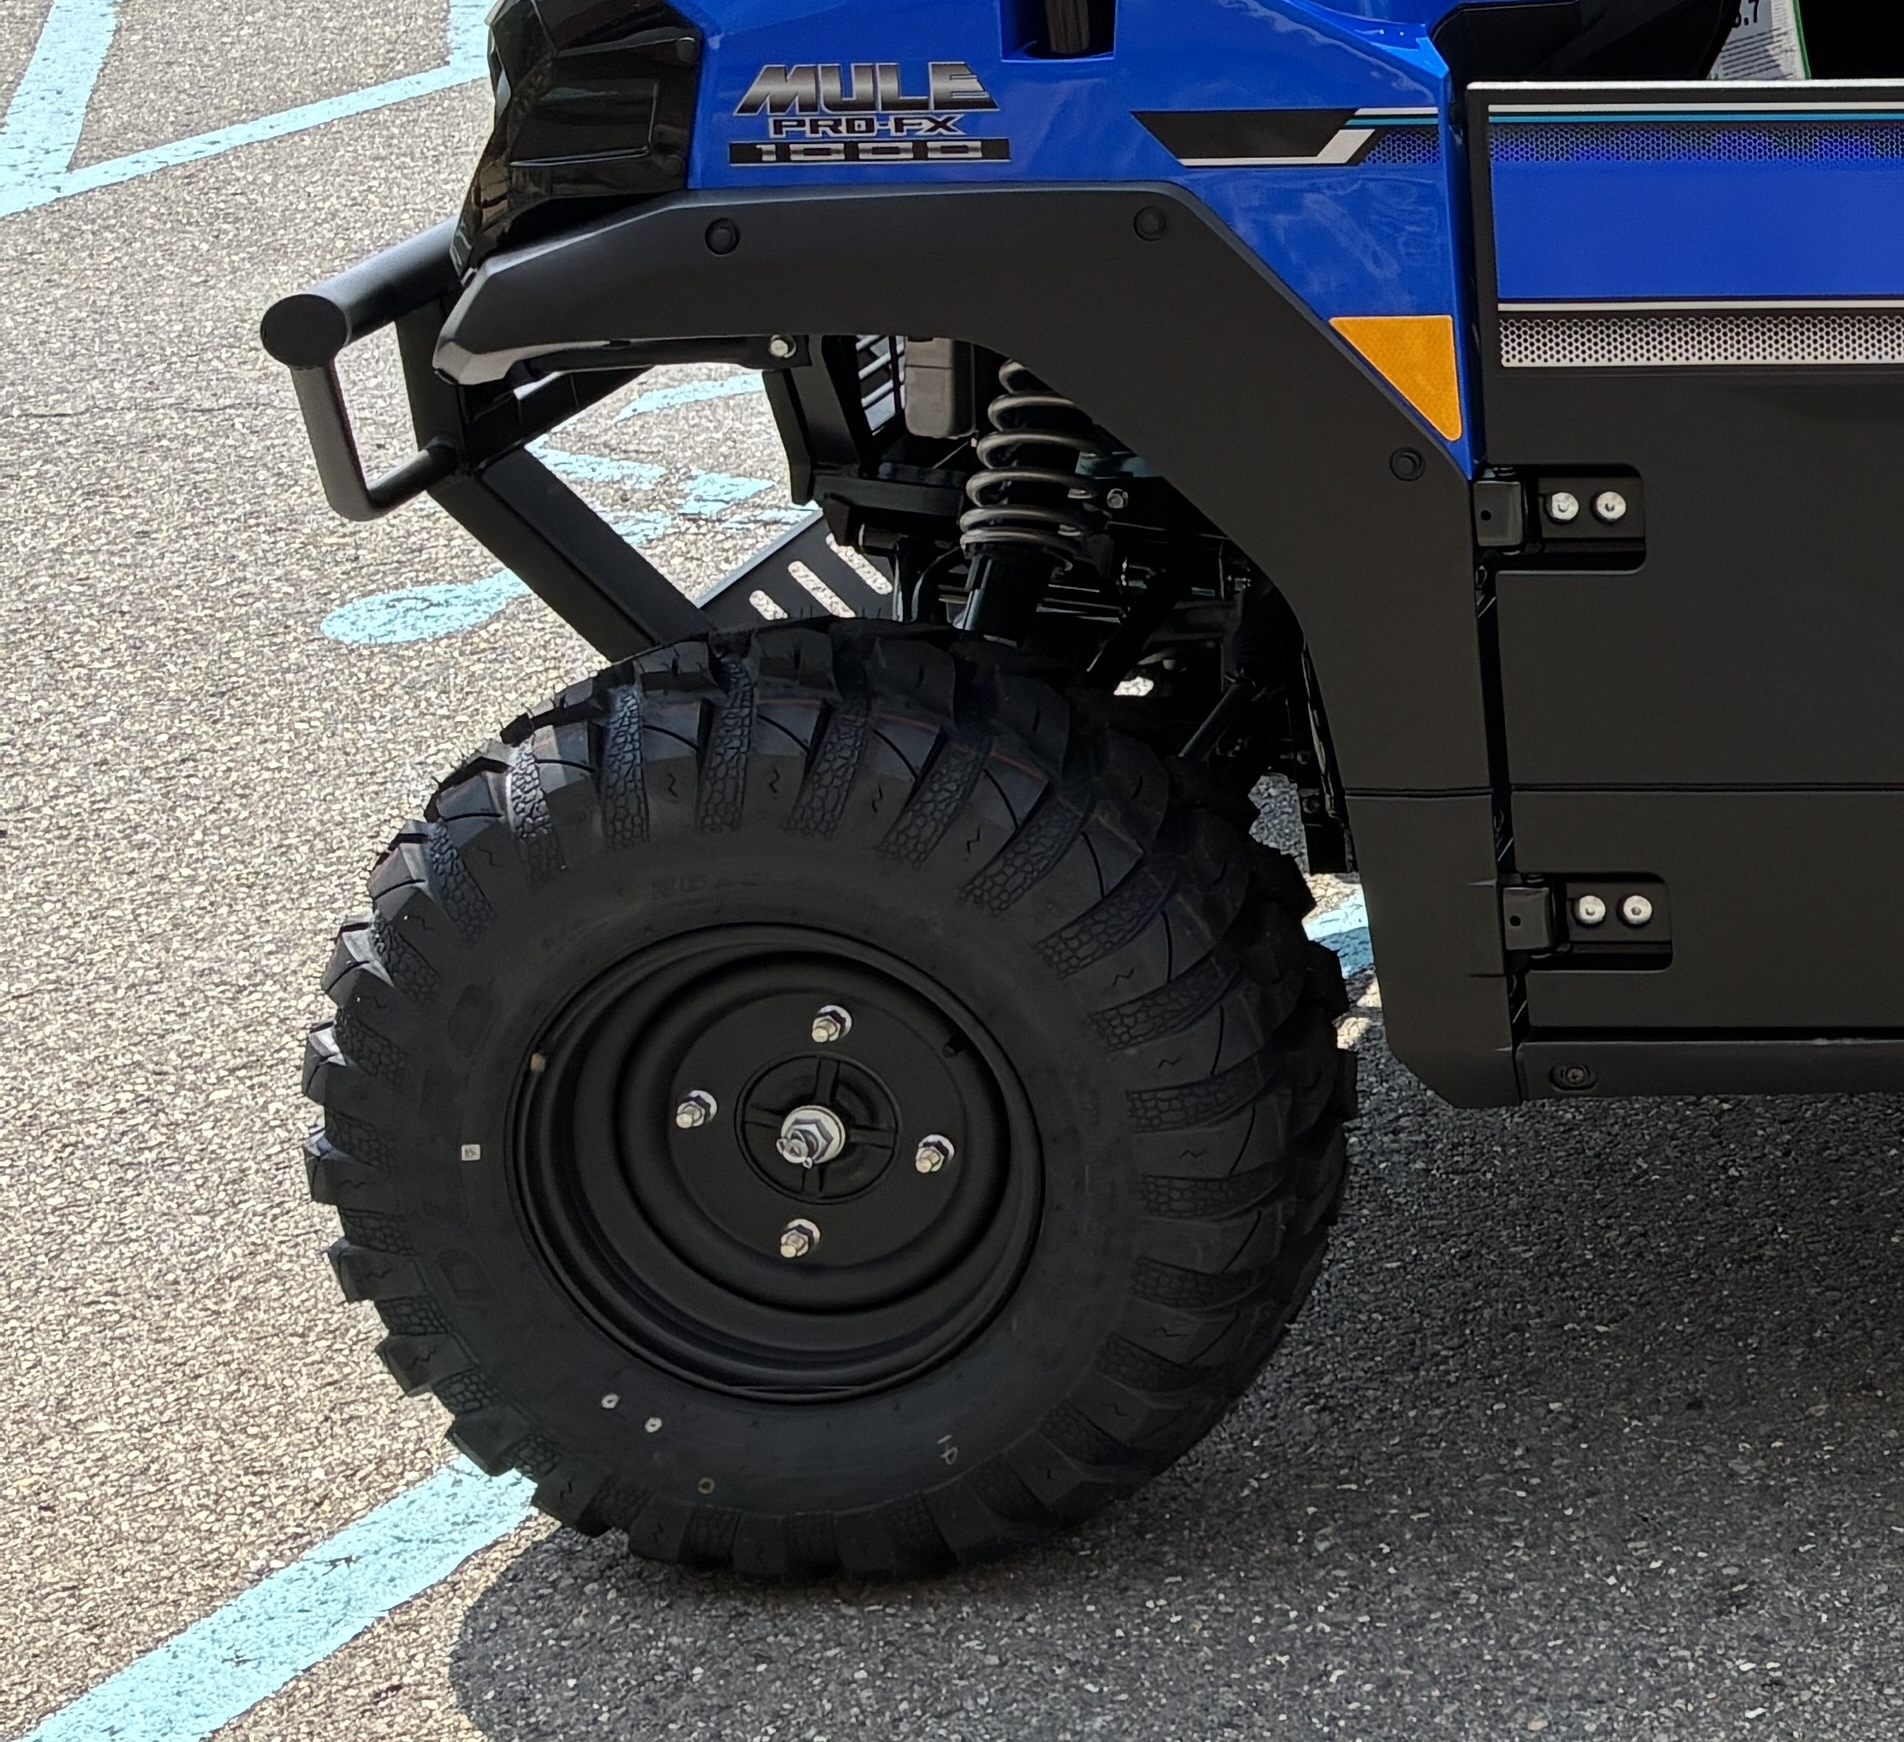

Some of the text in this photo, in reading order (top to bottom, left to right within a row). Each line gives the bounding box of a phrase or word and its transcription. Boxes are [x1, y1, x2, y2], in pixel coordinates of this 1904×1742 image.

[733, 61, 1000, 117] MULE
[768, 114, 967, 139] PRO-FX
[755, 140, 983, 162] 1000
